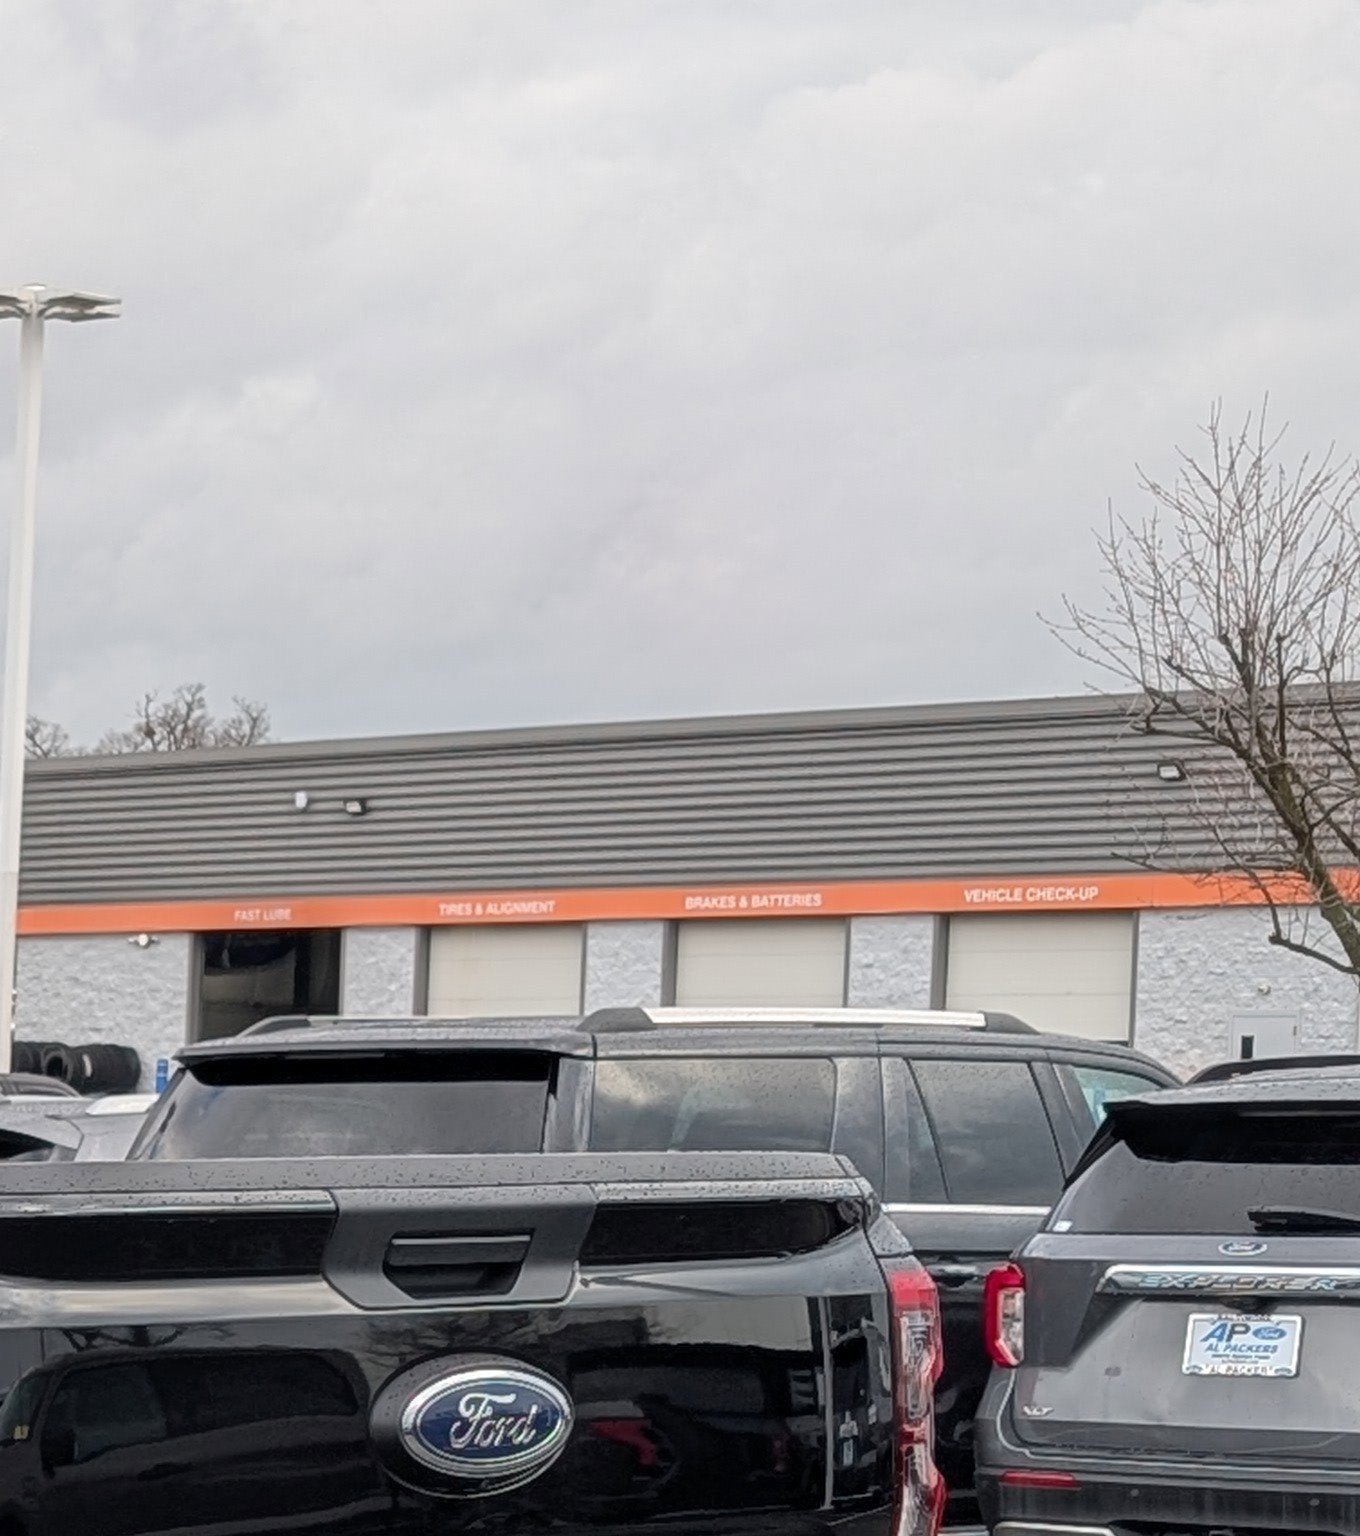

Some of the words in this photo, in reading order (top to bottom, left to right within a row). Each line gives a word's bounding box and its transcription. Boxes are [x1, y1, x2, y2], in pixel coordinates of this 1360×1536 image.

[684, 896, 737, 910] BRAKES
[738, 895, 748, 909] &
[751, 893, 822, 908] BATTERIES
[963, 888, 1023, 903] VEHICLE
[1025, 886, 1099, 901] CHECK-UP
[234, 909, 261, 922] FAST
[263, 908, 293, 921] LUBE
[439, 903, 473, 916] TIRES
[474, 903, 484, 915] &
[486, 901, 556, 915] ALIGNMENT
[1138, 1273, 1337, 1291] EXPLORER
[1200, 1322, 1251, 1342] AP
[1205, 1343, 1220, 1352] AL
[1223, 1344, 1279, 1354] PACKERS
[449, 1392, 538, 1450] Ford
